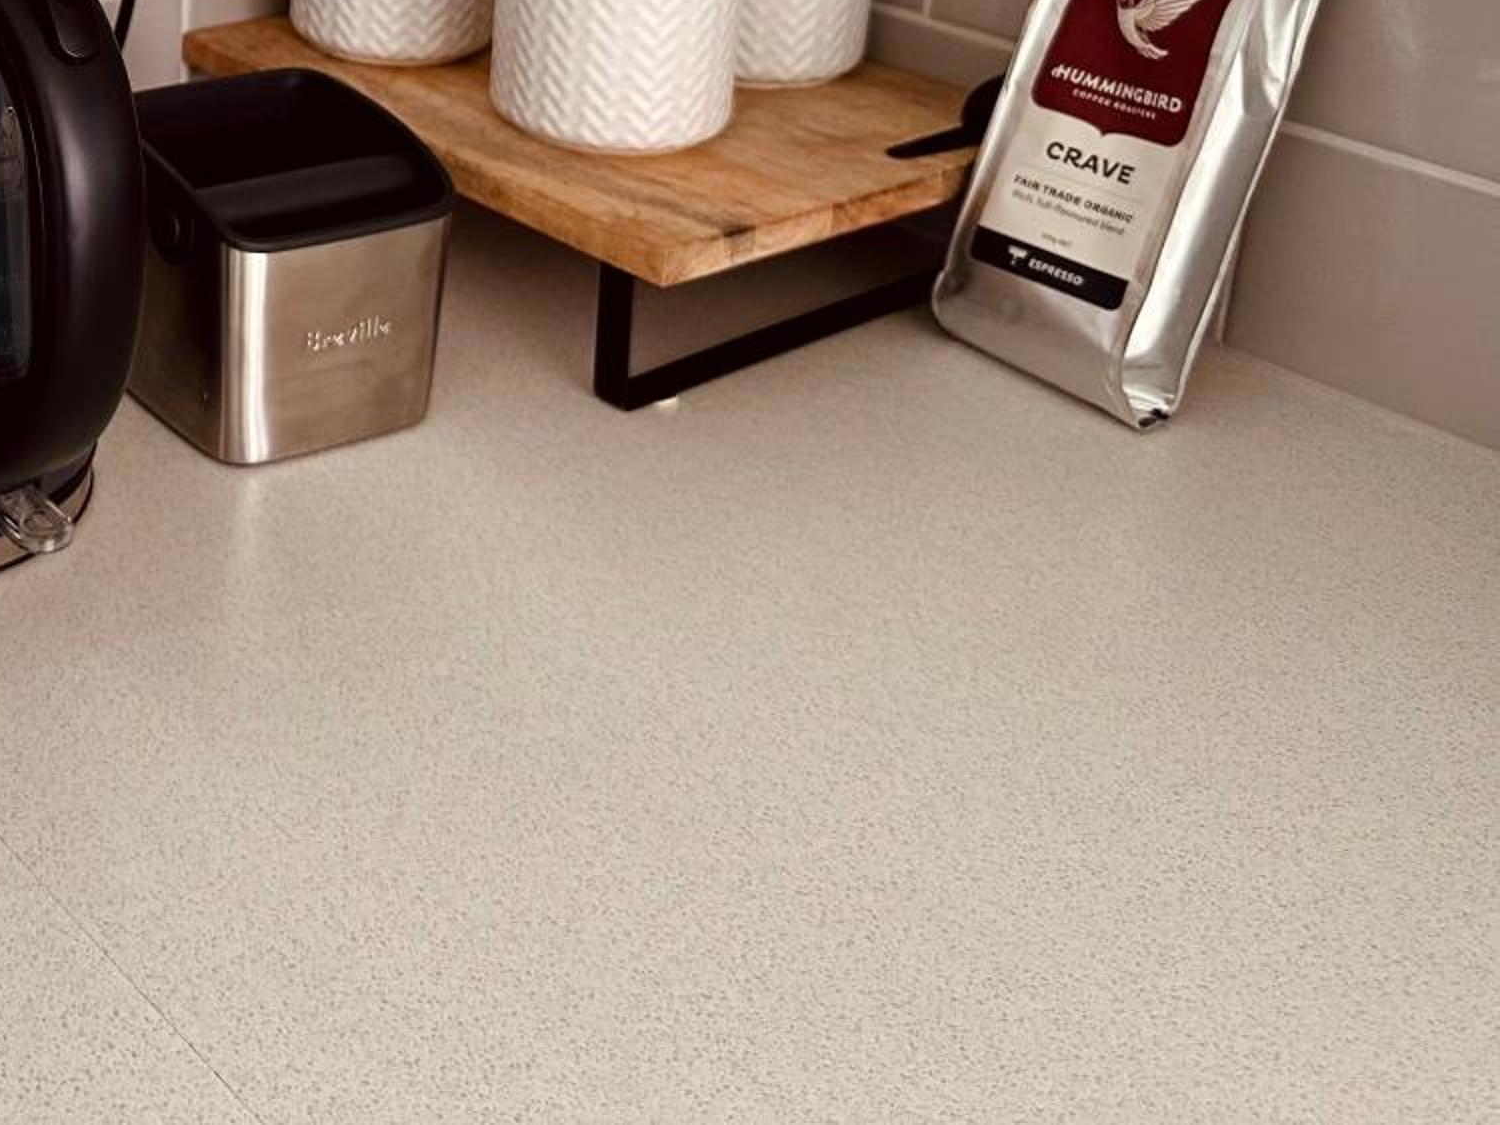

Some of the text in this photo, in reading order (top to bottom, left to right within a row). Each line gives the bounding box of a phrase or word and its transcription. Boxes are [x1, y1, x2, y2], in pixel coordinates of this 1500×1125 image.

[1051, 64, 1183, 114] HUMMINGBIRD
[1071, 88, 1112, 108] COFFEE
[1046, 141, 1136, 185] CRAVE
[1013, 174, 1133, 224] FAIR TRADE ORGANIC
[1028, 257, 1084, 286] ESPRESSO
[307, 315, 391, 351] Breville
